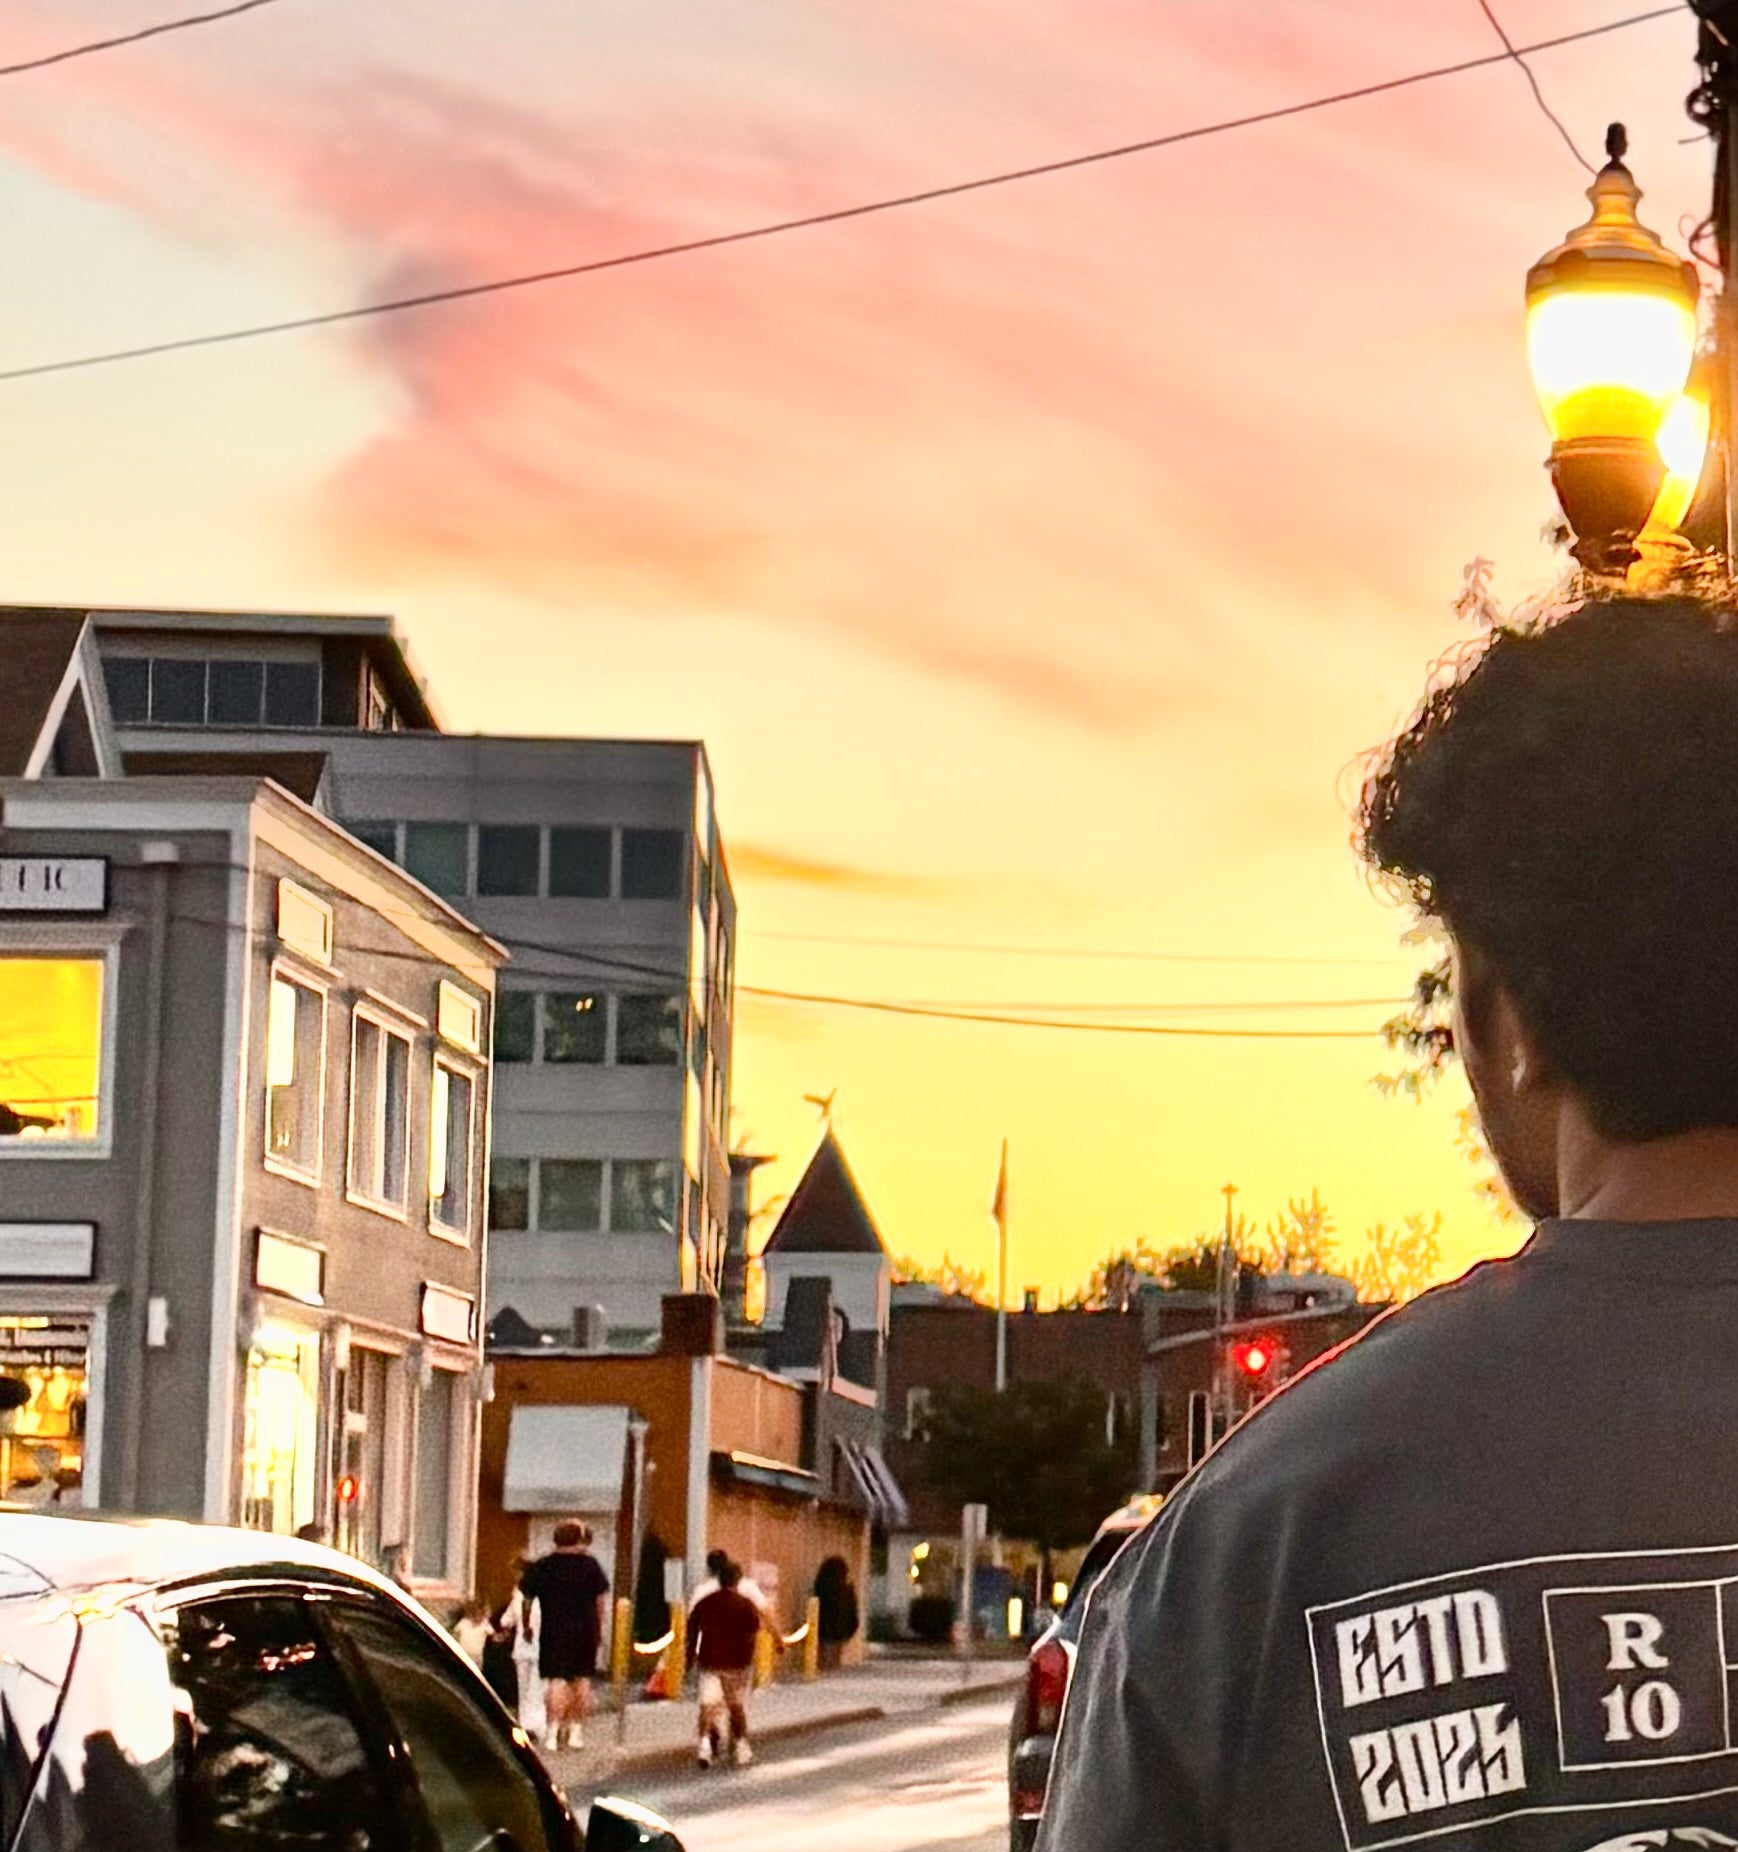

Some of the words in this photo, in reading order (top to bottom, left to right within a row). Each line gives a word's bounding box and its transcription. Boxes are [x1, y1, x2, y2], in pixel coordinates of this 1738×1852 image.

[1335, 1589, 1507, 1708] ESTD
[1600, 1612, 1670, 1670] R
[1600, 1680, 1682, 1743] 10
[1349, 1702, 1527, 1824] 2025
